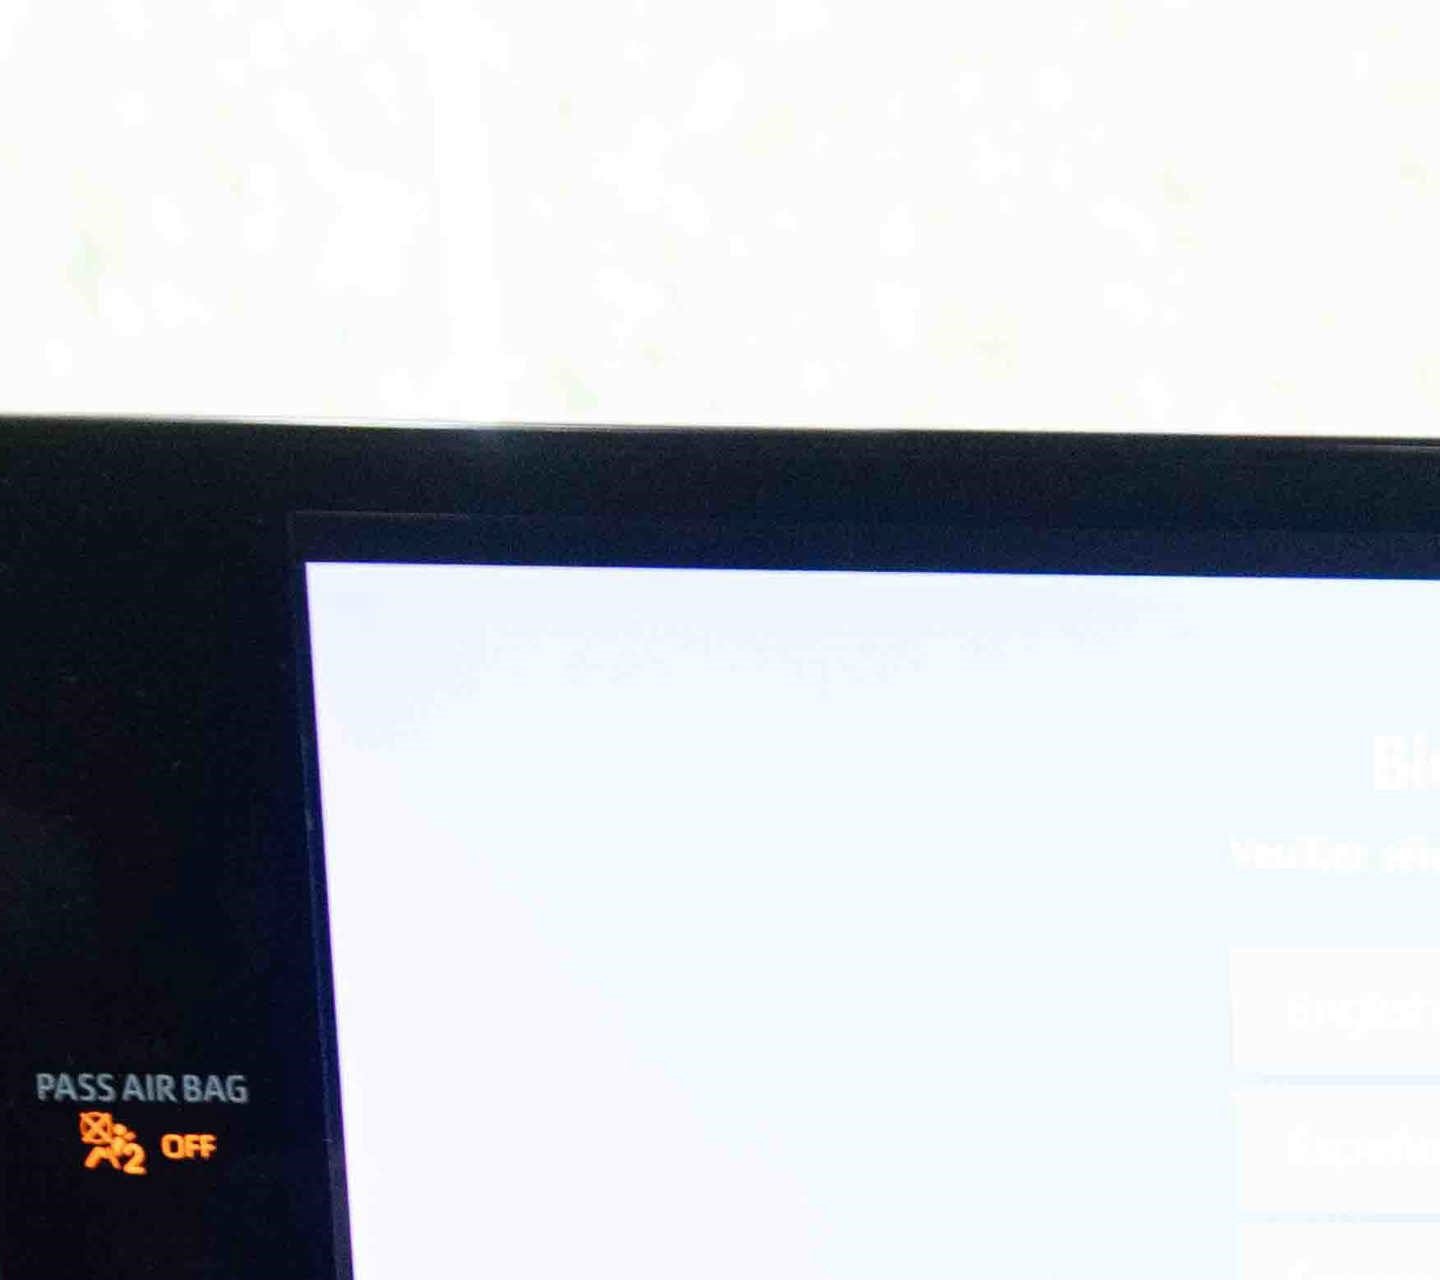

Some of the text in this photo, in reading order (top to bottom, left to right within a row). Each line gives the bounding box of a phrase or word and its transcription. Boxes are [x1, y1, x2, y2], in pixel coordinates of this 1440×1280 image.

[36, 1072, 248, 1104] PASS AIR BAG
[160, 1133, 217, 1160] OFF
